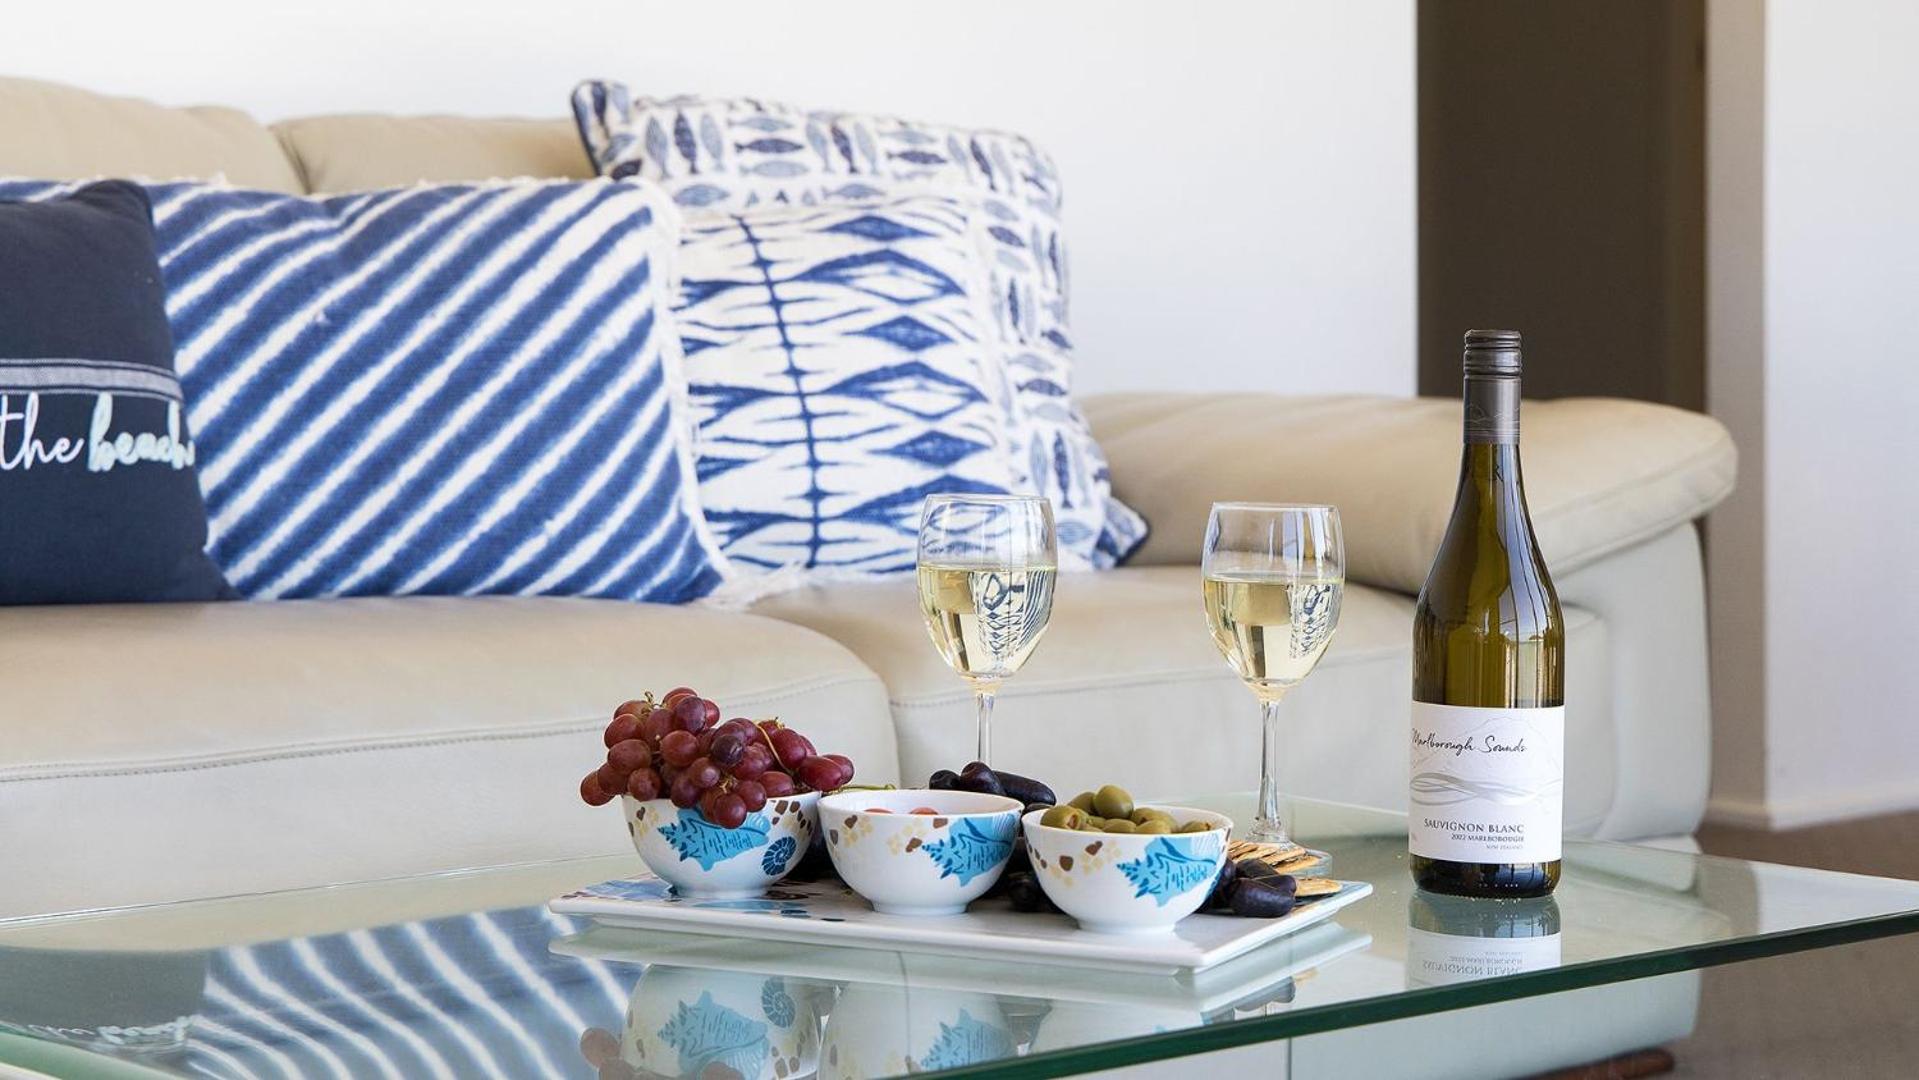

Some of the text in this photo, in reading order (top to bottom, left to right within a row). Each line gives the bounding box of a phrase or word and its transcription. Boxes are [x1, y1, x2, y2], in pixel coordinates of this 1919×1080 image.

[0, 392, 196, 473] the beach
[1411, 728, 1526, 757] Marlborough Sounds
[1424, 818, 1524, 833] SAUVIGNON BLANC
[1467, 834, 1524, 843] MARLBOROUGH
